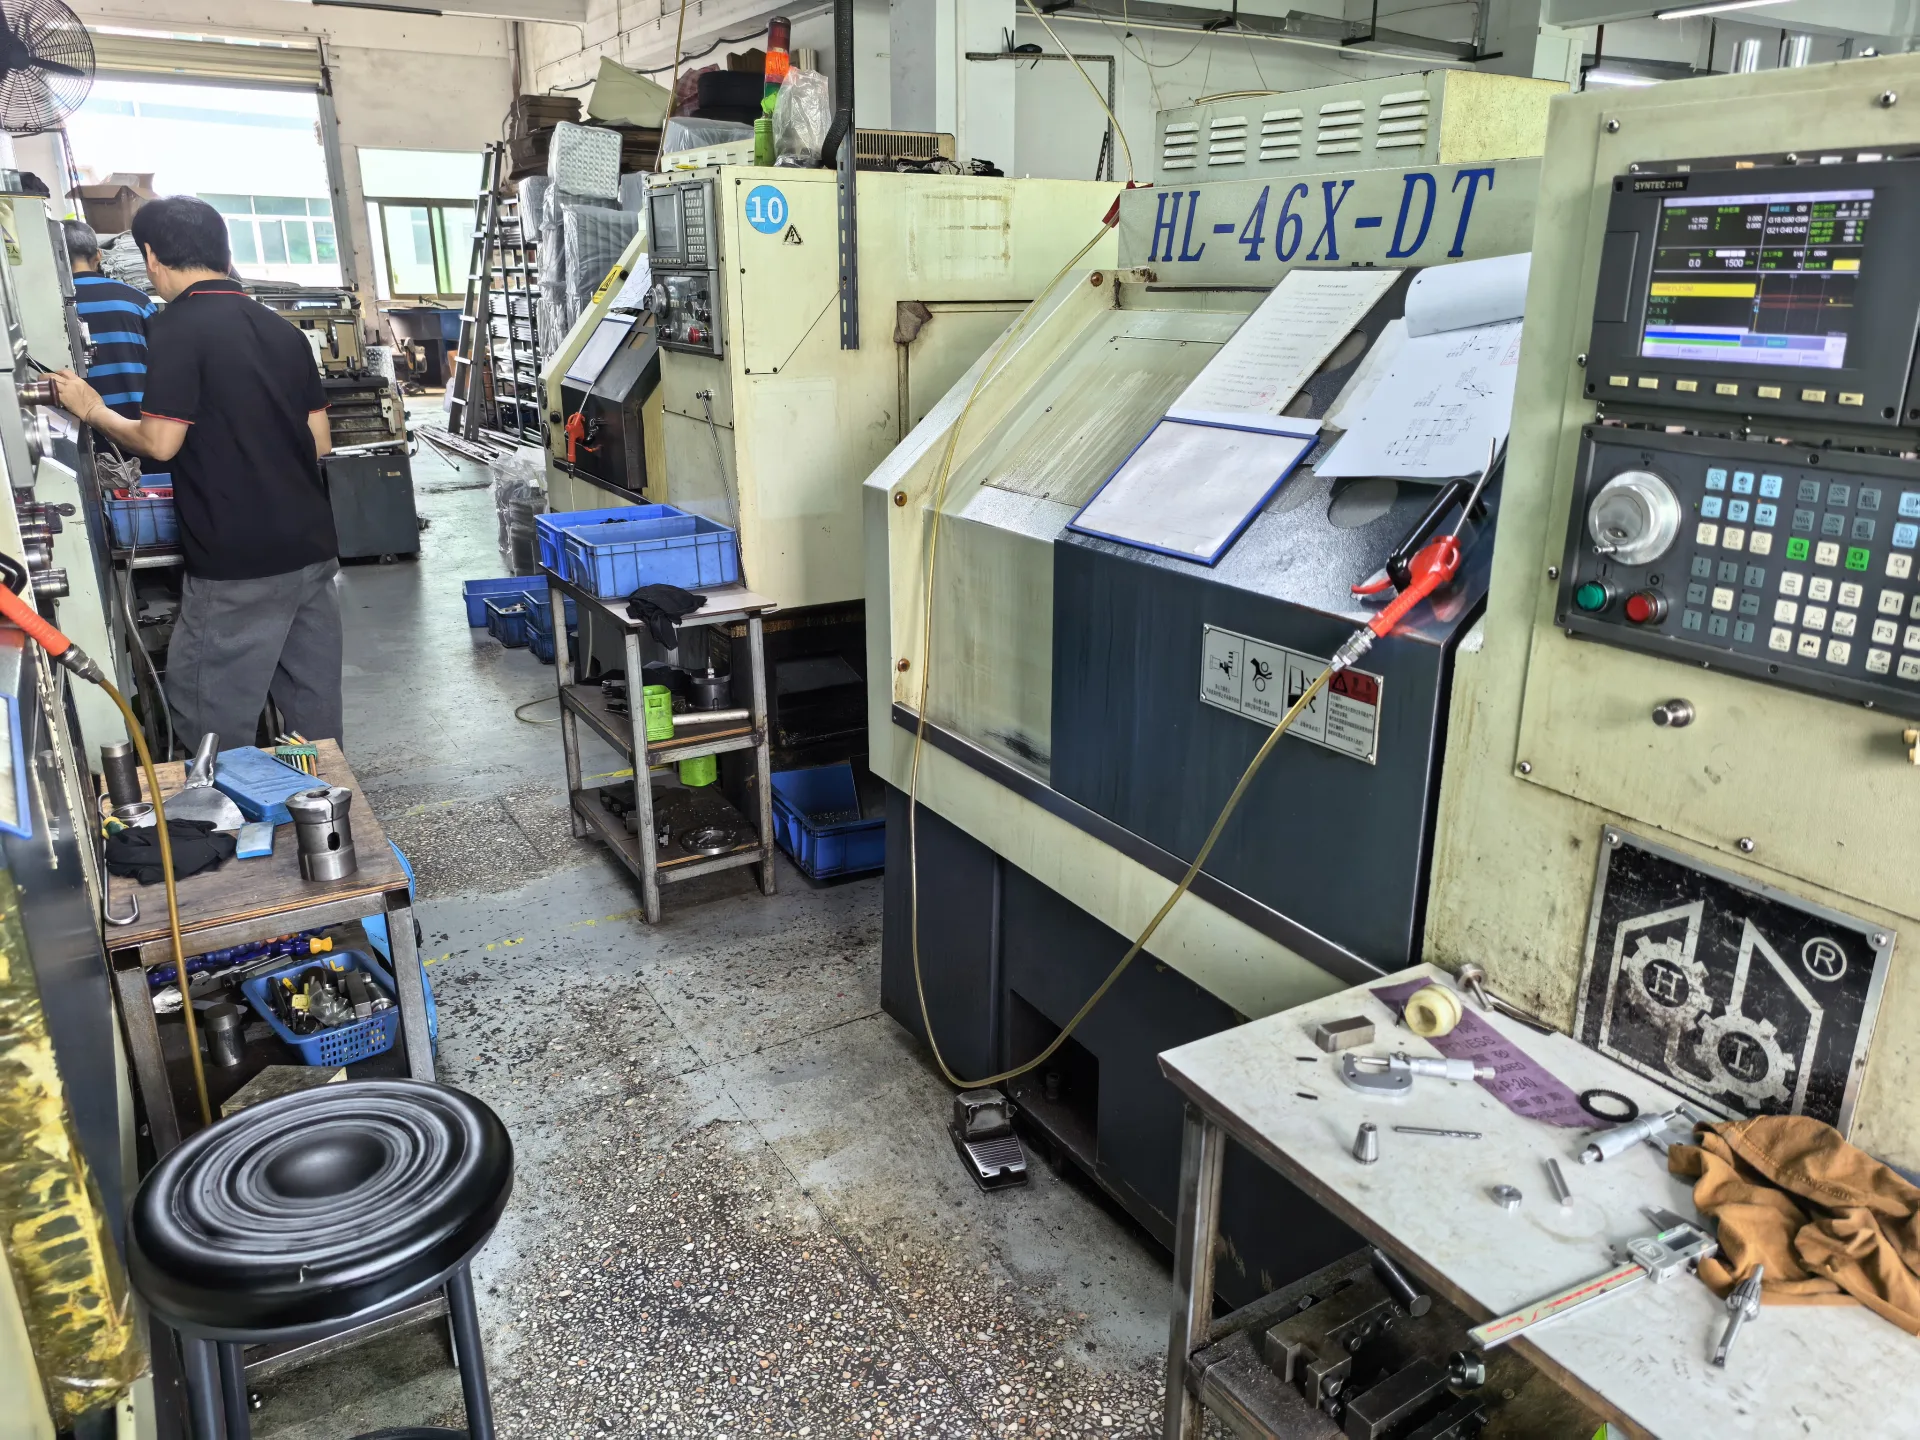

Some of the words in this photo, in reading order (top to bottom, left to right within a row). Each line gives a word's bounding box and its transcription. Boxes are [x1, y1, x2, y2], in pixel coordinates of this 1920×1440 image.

[1634, 181, 1666, 190] SYNTEC
[750, 196, 783, 225] 10
[1147, 167, 1495, 263] HL-46X-DT
[1688, 259, 1702, 268] 0.0
[1725, 259, 1744, 268] 1500
[1883, 596, 1899, 609] F1
[1876, 625, 1893, 639] F3
[1647, 962, 1684, 1005] H
